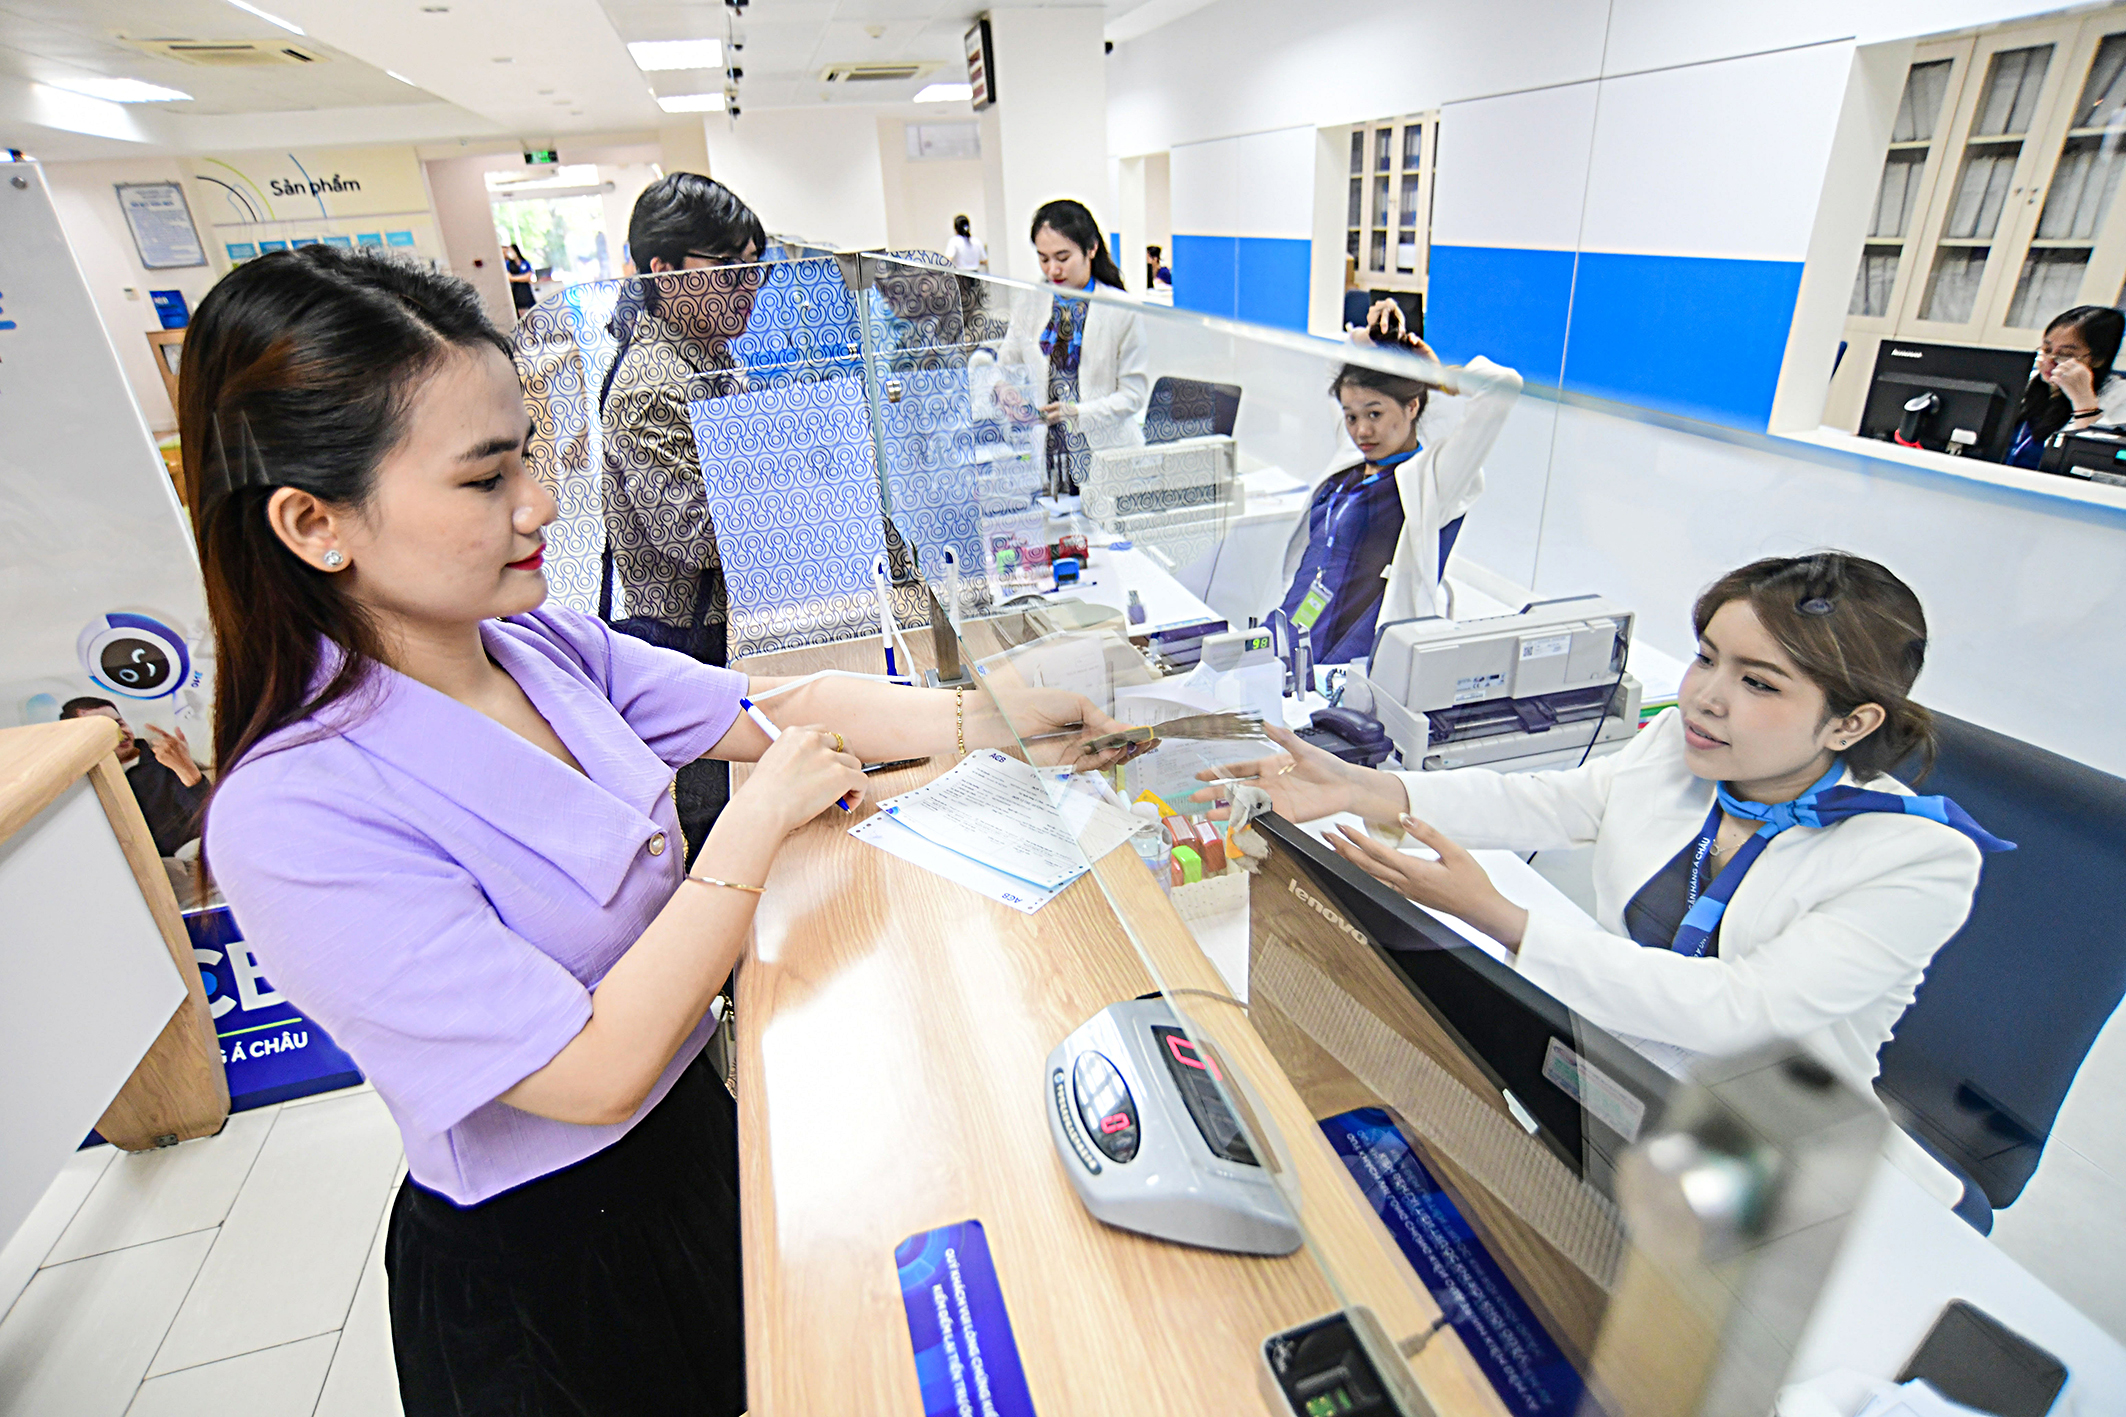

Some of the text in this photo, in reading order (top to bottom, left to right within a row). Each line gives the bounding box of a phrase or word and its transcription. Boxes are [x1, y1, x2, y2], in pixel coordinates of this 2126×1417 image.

[270, 174, 361, 197] Sản phẩm
[989, 752, 1007, 764] ACB
[1288, 878, 1368, 946] lenovo
[231, 1041, 247, 1063] Á
[249, 1031, 309, 1058] CHÂU
[950, 1269, 966, 1305] KHÁCH
